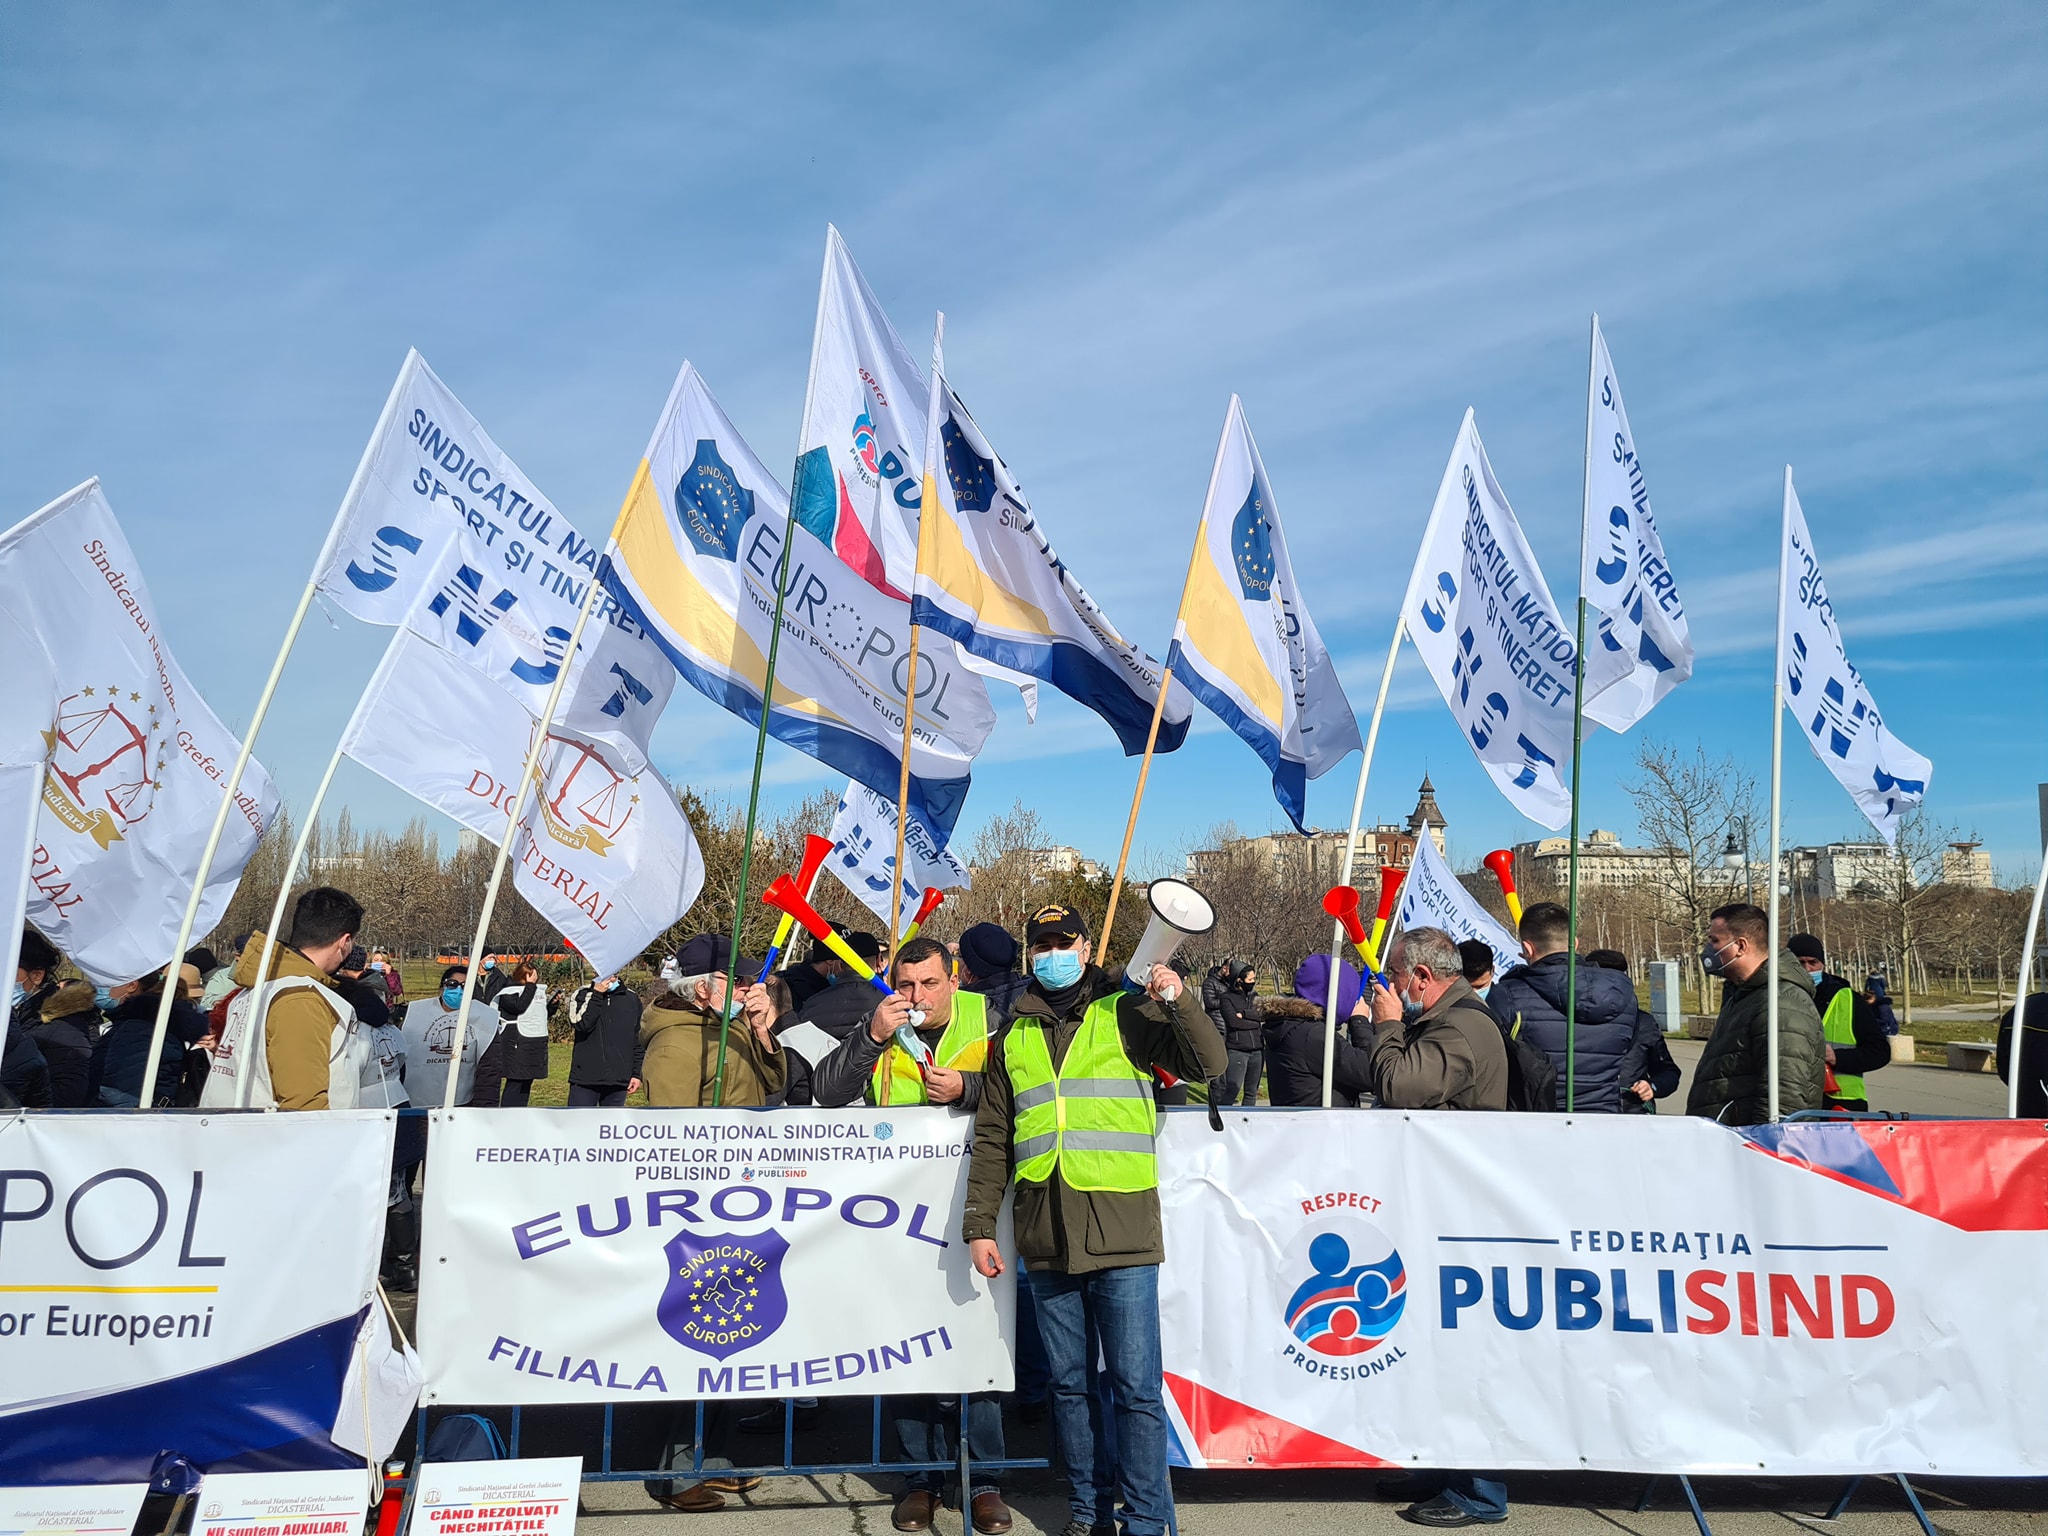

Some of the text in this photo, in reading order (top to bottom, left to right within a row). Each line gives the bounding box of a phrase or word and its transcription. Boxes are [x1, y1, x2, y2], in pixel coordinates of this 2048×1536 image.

[407, 408, 553, 547] SINDICATUL
[697, 465, 740, 515] SINDICATUL
[1461, 463, 1519, 603] SINDICATUL
[412, 466, 504, 548] SPORT
[538, 560, 650, 642] TINERET
[82, 539, 152, 635] Sindicatul
[1461, 519, 1489, 601] SPORT
[1496, 615, 1572, 709] TINERET
[872, 695, 939, 748] Euroeni
[175, 730, 224, 782] Grefei
[599, 1124, 678, 1140] BLOCUL
[783, 1124, 870, 1140] SINDICAL
[586, 1148, 718, 1163] SINDICATELOR
[723, 1148, 752, 1162] DIN
[899, 1140, 973, 1159] PUBLICĂ
[635, 1165, 731, 1181] PUBLISIND
[758, 1170, 807, 1178] PUBLISIND
[1300, 1191, 1382, 1216] RESPECT
[511, 1185, 949, 1261] EUROPOL
[679, 1245, 768, 1279] SINDICATUL
[1438, 1263, 1896, 1340] PUBLISIND
[46, 1305, 216, 1346] Europeni
[683, 1320, 763, 1345] EUROPOL
[487, 1325, 954, 1393] FILIALA MEHEDINTI
[1282, 1343, 1408, 1381] PROFESIONAL
[267, 1504, 325, 1514] DICASTERIAL
[482, 1490, 536, 1500] DICASTERIAL
[37, 1516, 95, 1526] DICASTERIAL
[281, 1521, 349, 1536] AUXILIARI,
[429, 1508, 474, 1521] CÂND
